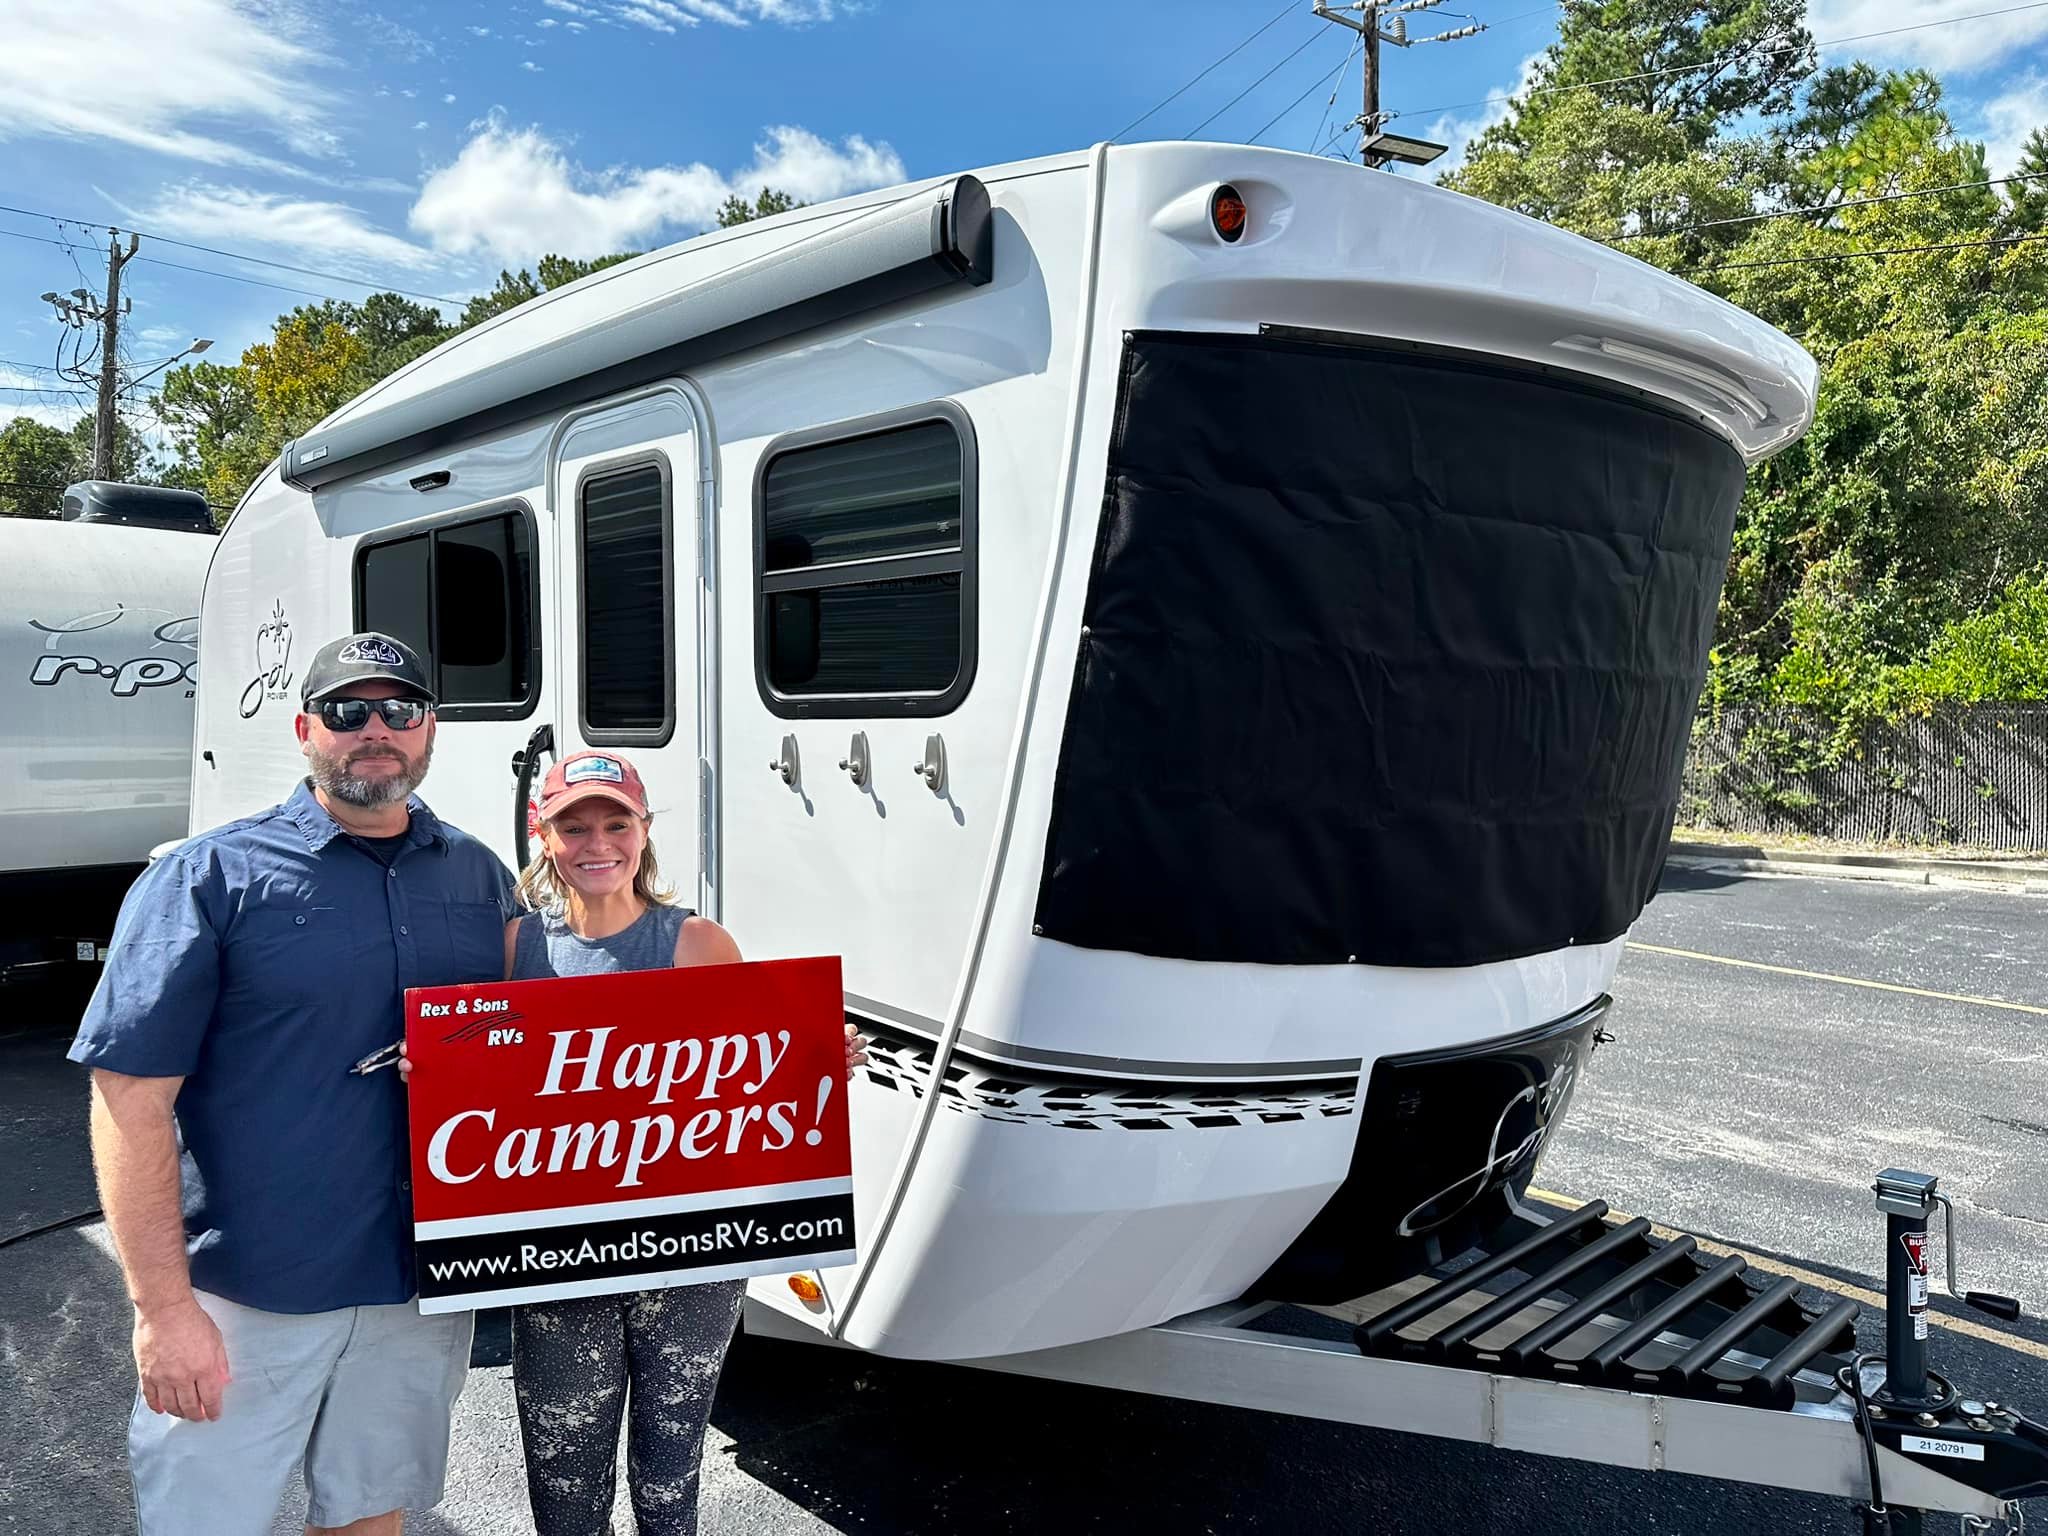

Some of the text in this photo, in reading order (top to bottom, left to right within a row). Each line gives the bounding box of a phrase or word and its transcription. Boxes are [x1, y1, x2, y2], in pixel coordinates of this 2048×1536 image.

[360, 641, 396, 664] Surf City
[420, 996, 509, 1018] Rex & Sons
[487, 1028, 524, 1047] RVs
[534, 1026, 791, 1105] Happy
[426, 1074, 834, 1188] Campers!
[428, 1216, 844, 1281] www.RexAndSonsRVs.com
[1920, 1440, 1965, 1454] 21 20791
